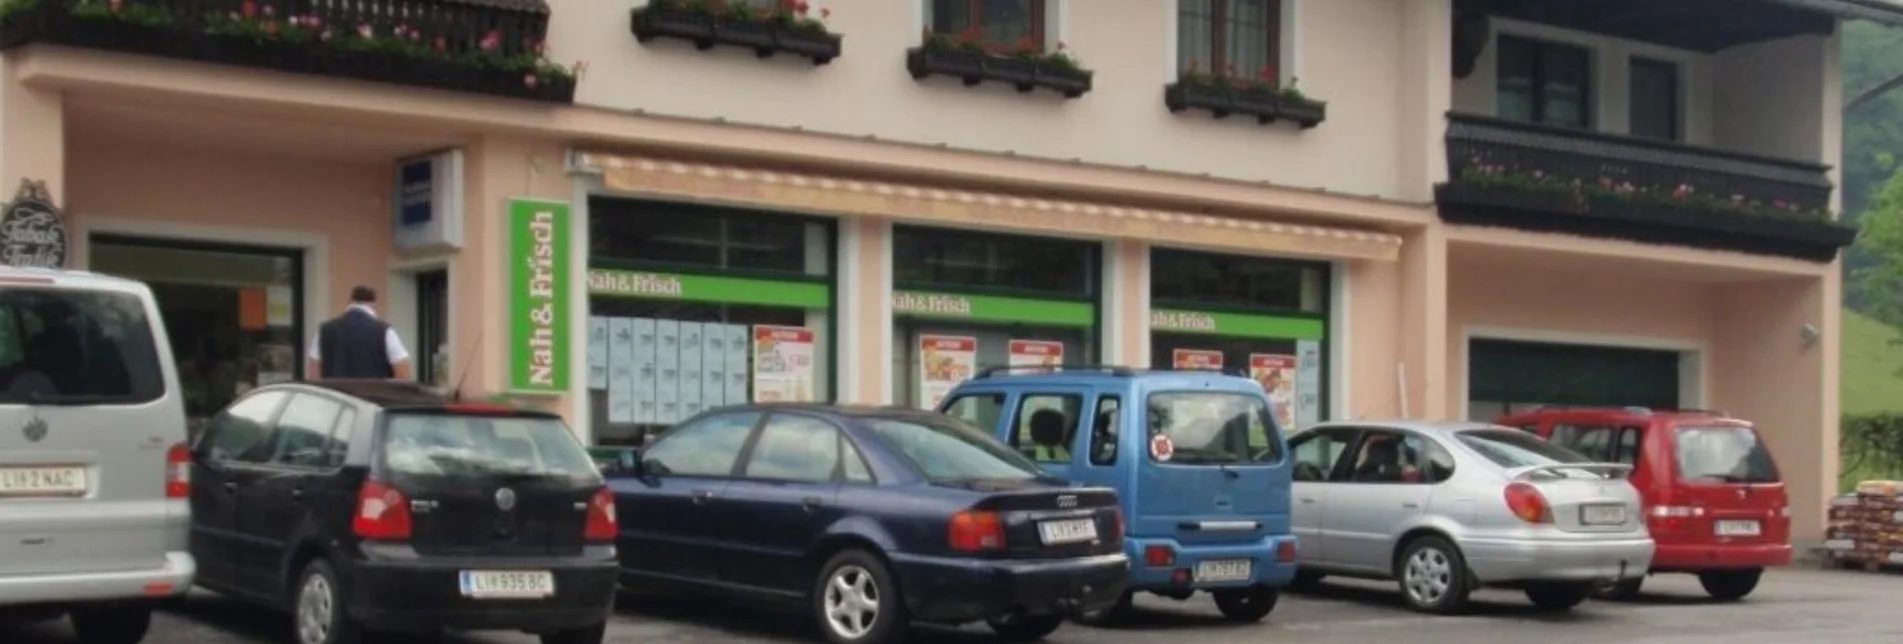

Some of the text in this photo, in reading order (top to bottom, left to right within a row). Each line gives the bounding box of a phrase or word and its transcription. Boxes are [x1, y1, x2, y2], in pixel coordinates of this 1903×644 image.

[3, 220, 63, 243] Tabak
[633, 274, 682, 297] Frisch
[527, 211, 554, 386] Nah & Frisch
[929, 295, 970, 313] Frisch
